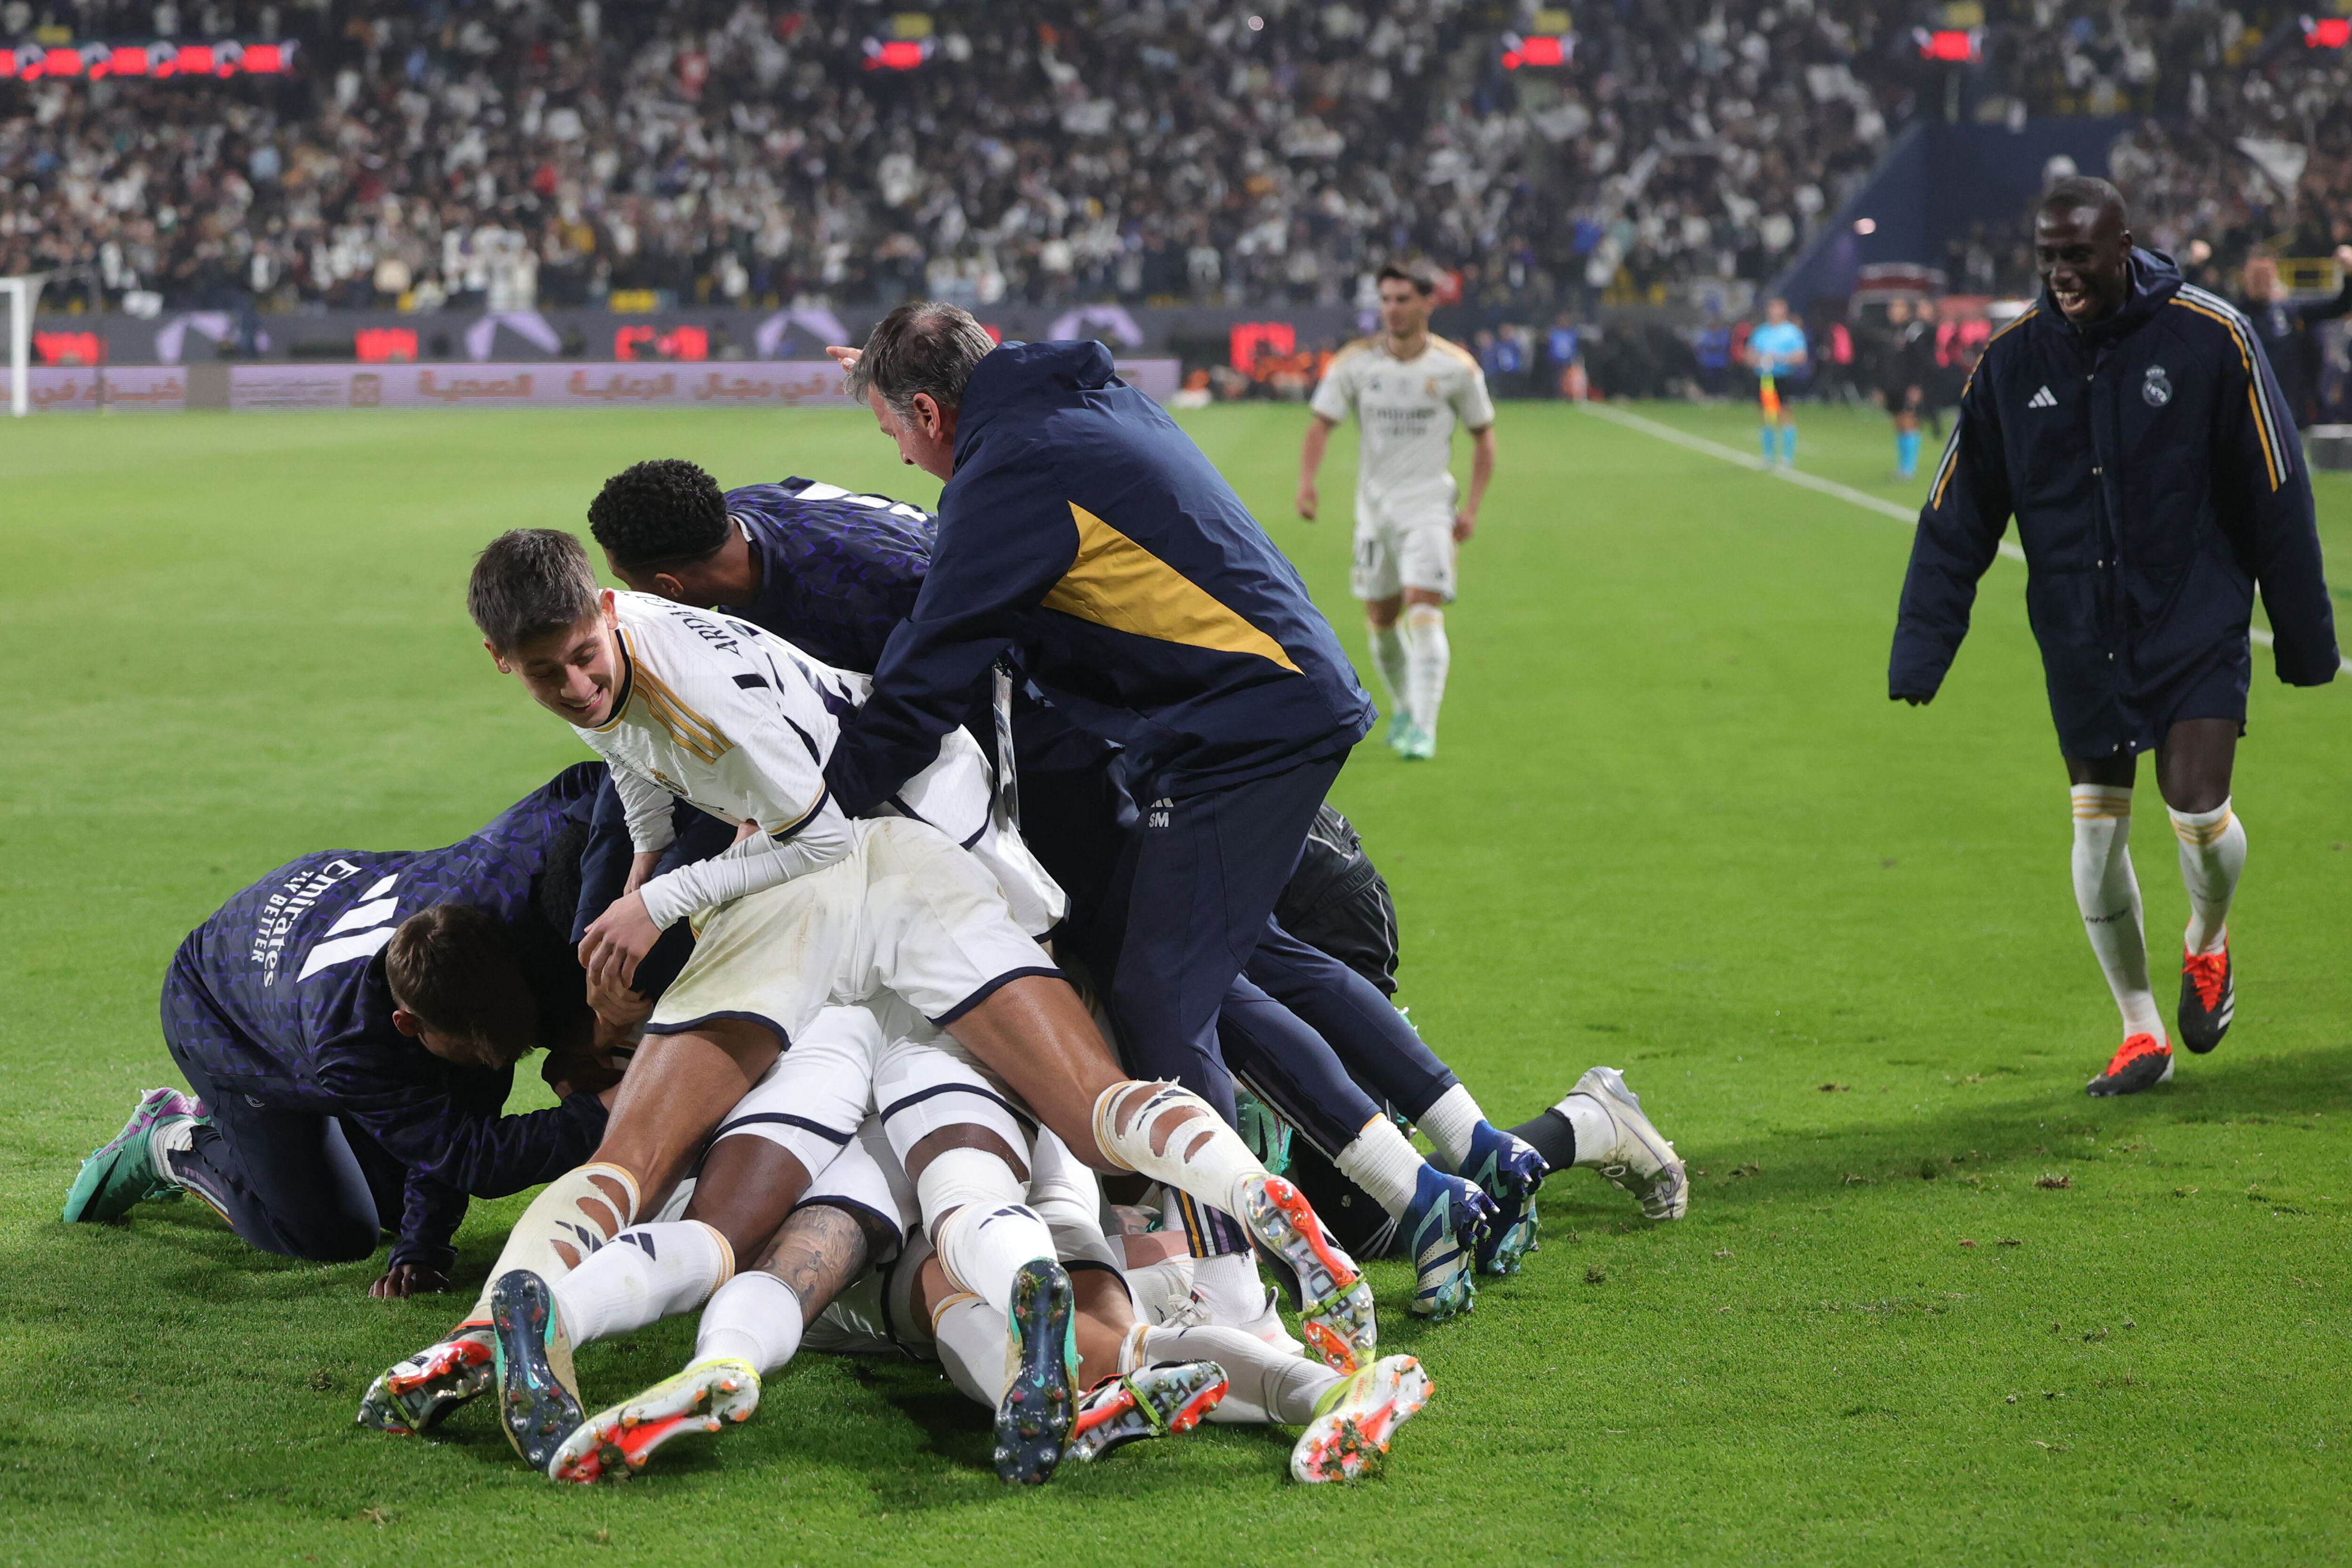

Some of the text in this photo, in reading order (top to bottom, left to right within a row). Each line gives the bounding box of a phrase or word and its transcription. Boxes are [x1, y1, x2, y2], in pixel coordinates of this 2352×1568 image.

[669, 611, 743, 659] ARDA
[1149, 812, 1169, 828] SM
[251, 893, 288, 963] BETTER
[263, 858, 363, 988] Emirates
